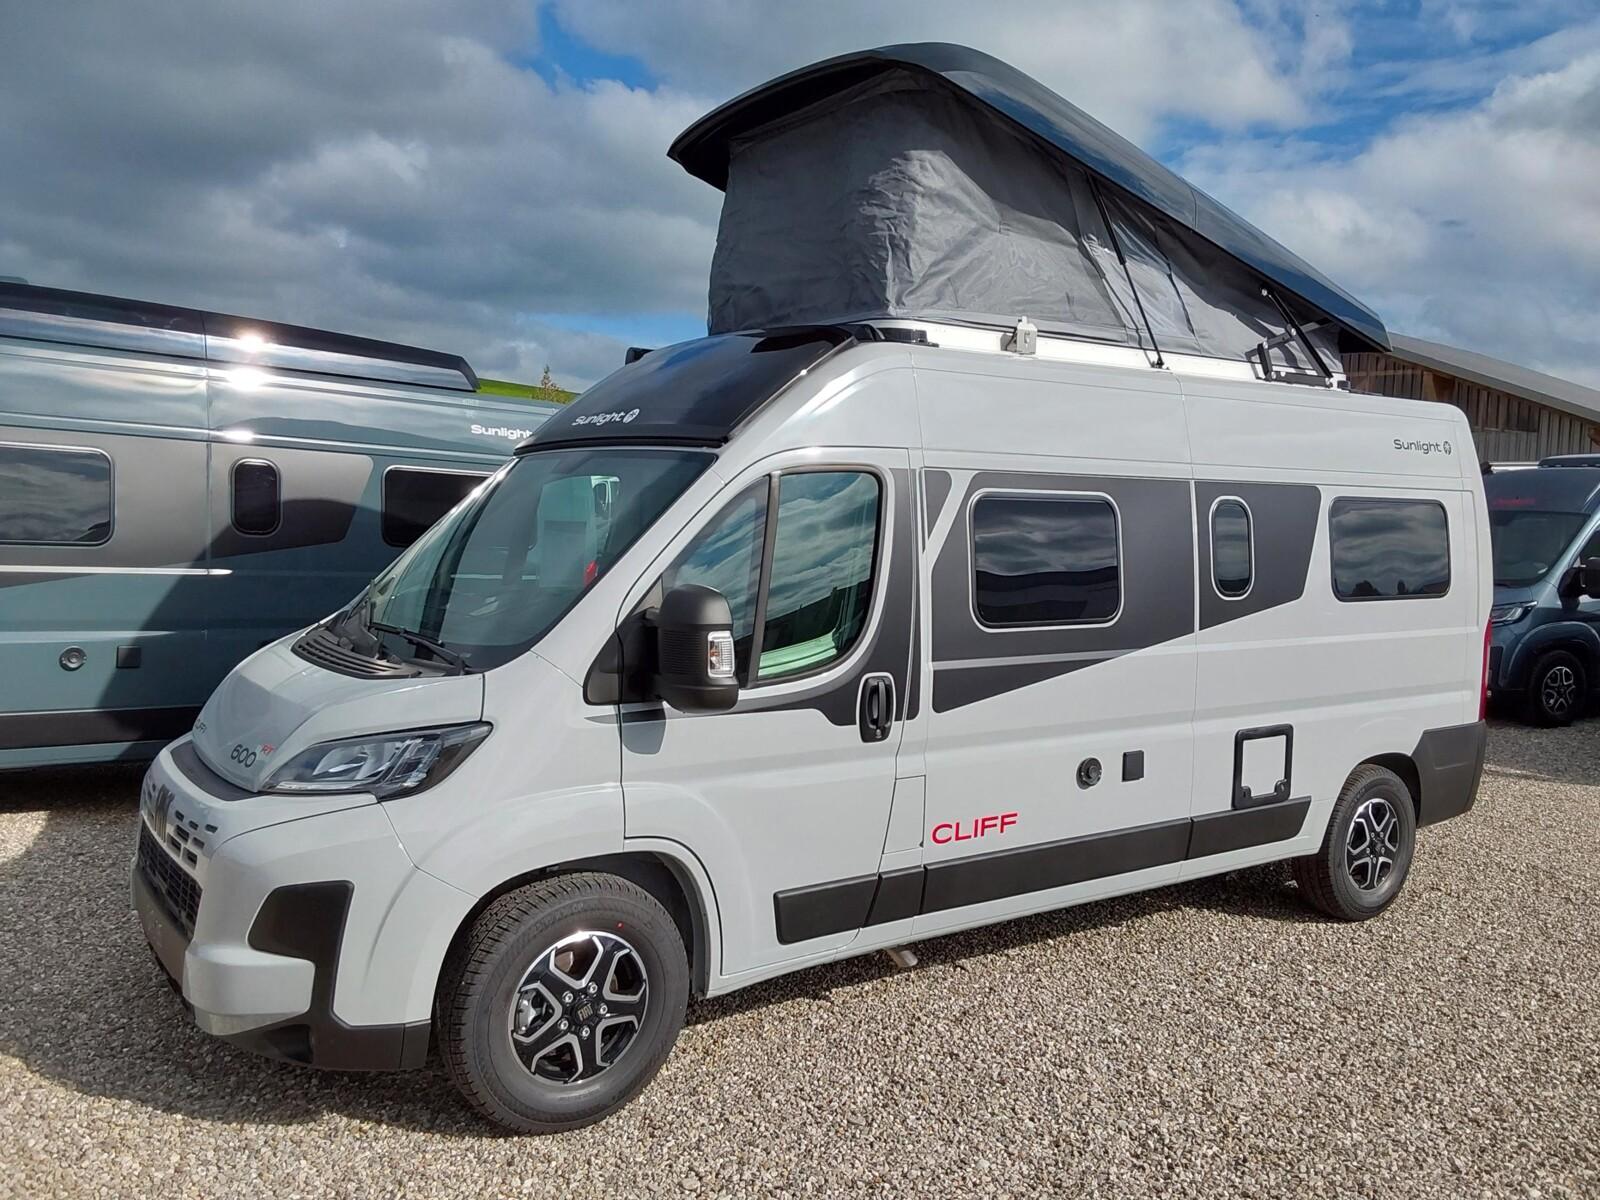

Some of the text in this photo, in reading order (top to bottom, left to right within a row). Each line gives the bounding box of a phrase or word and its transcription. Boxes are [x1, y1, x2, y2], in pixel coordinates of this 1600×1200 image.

[570, 411, 625, 426] Sunlight
[470, 424, 534, 440] Sunlight
[1393, 438, 1442, 455] Sunlight
[230, 743, 257, 768] 600
[931, 812, 1018, 845] CLIFF
